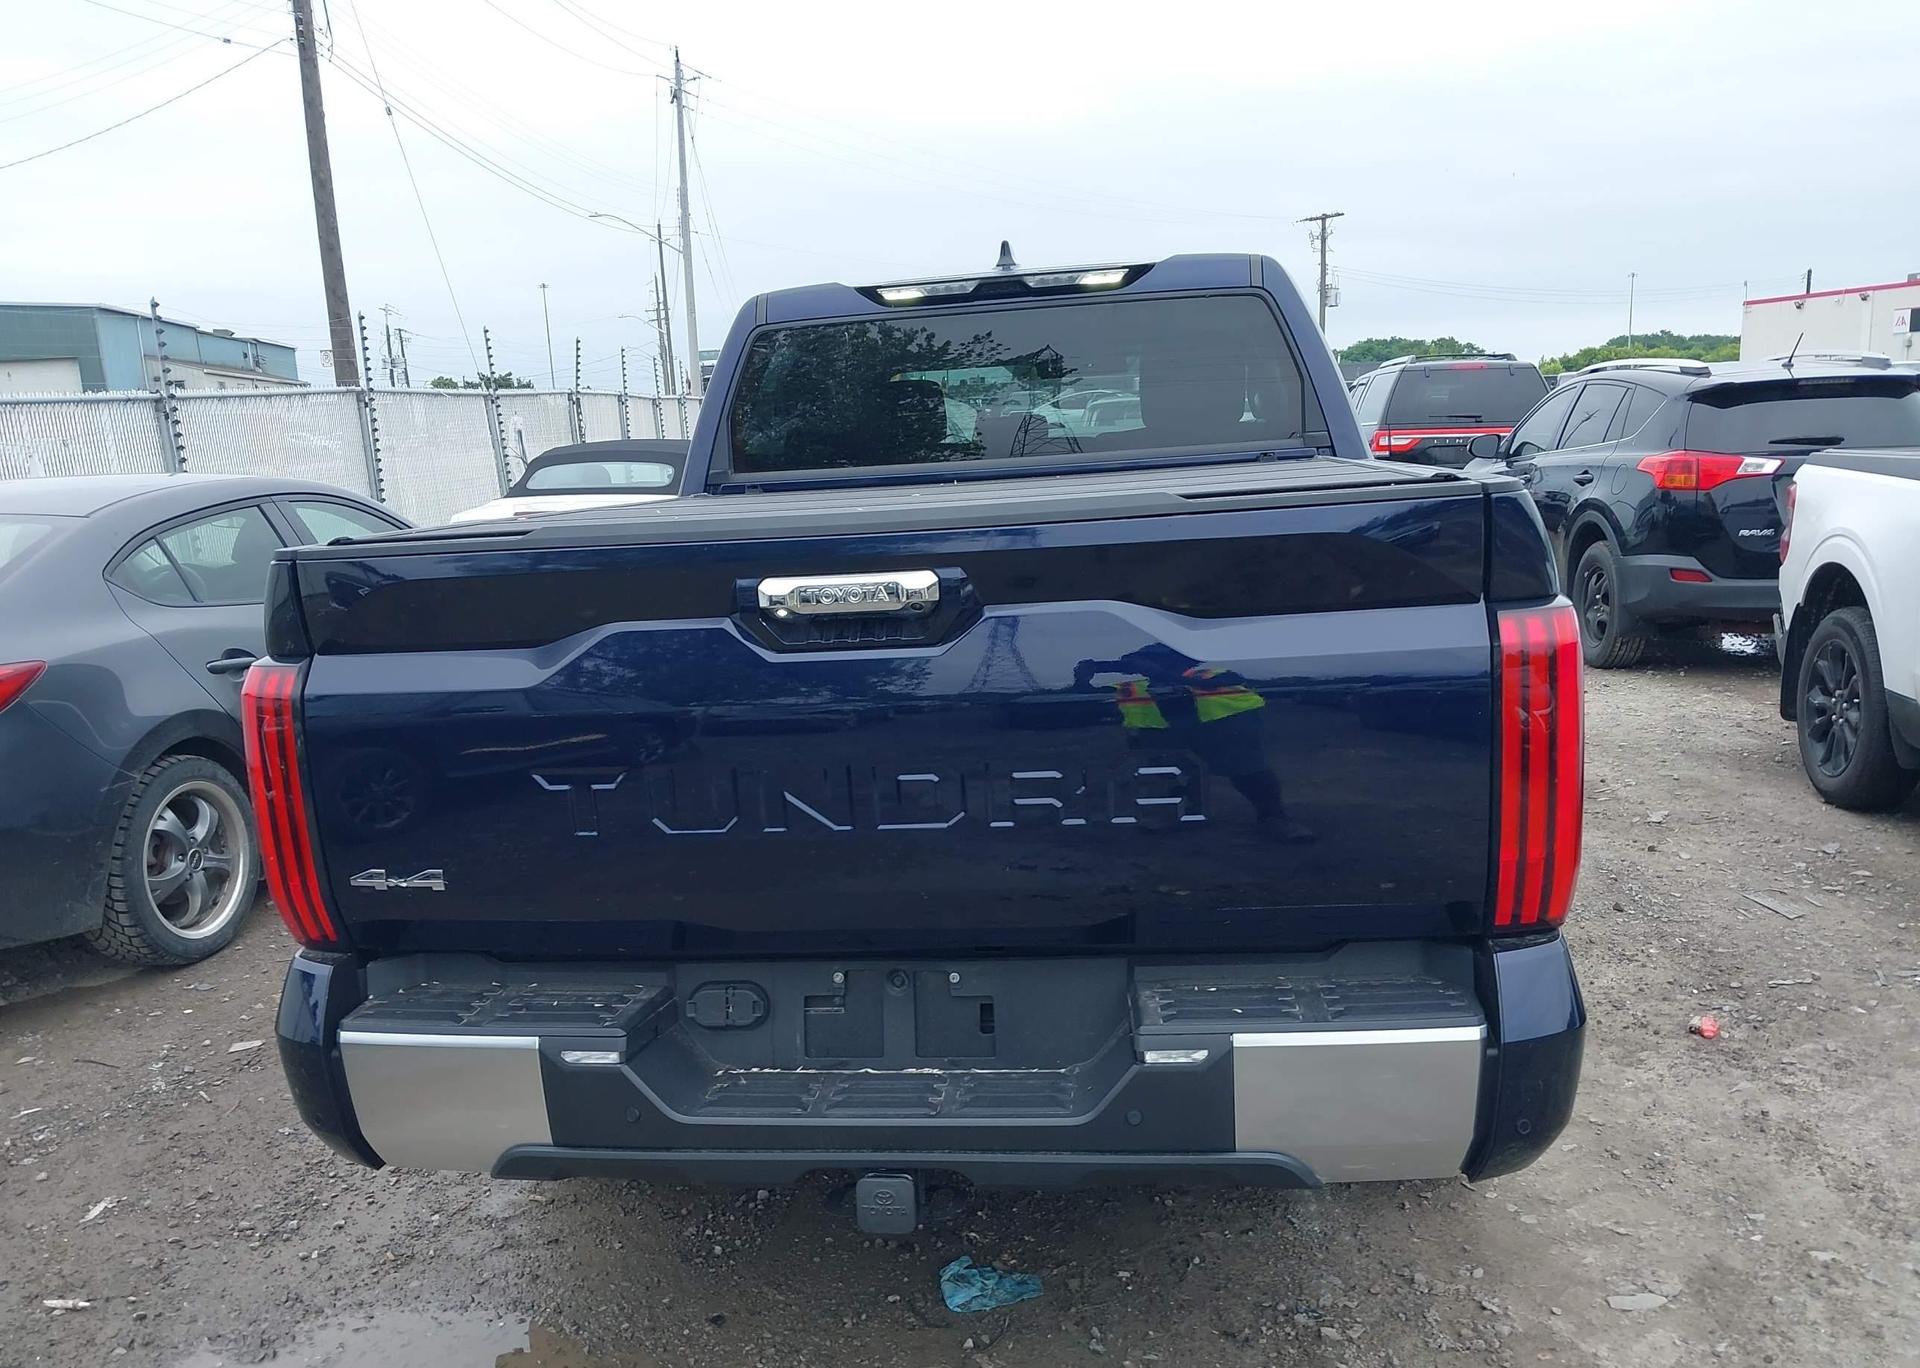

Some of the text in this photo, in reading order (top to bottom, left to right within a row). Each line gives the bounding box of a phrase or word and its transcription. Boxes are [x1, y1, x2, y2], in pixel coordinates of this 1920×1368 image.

[1738, 528, 1775, 537] RAV4
[806, 584, 891, 605] TOYOTA
[531, 763, 1208, 836] TUNDRA
[349, 868, 447, 891] 4x4
